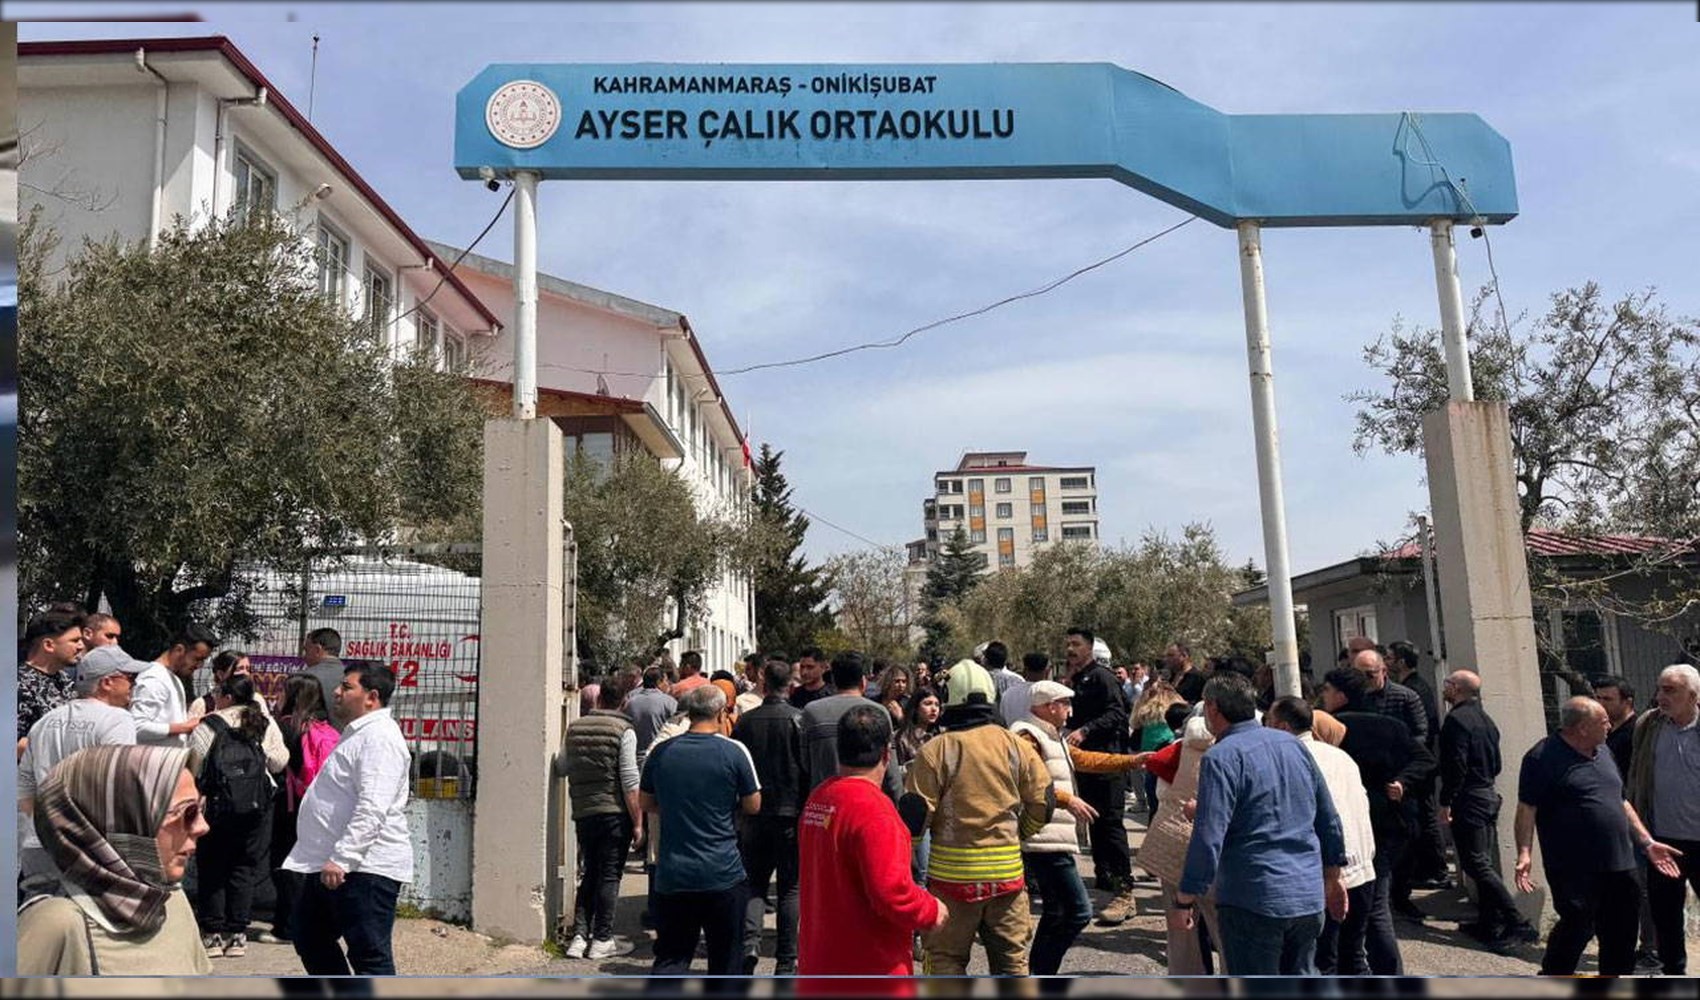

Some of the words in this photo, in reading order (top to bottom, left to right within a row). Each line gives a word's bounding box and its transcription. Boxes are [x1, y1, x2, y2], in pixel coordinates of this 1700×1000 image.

[594, 76, 792, 98] KAHRAMANMARAŞ
[811, 73, 937, 98] ONİKİŞUBAT
[574, 109, 689, 140] AYSER
[698, 109, 801, 148] ÇALIK
[810, 109, 1015, 140] ORTAOKULU
[390, 623, 411, 639] T.C.
